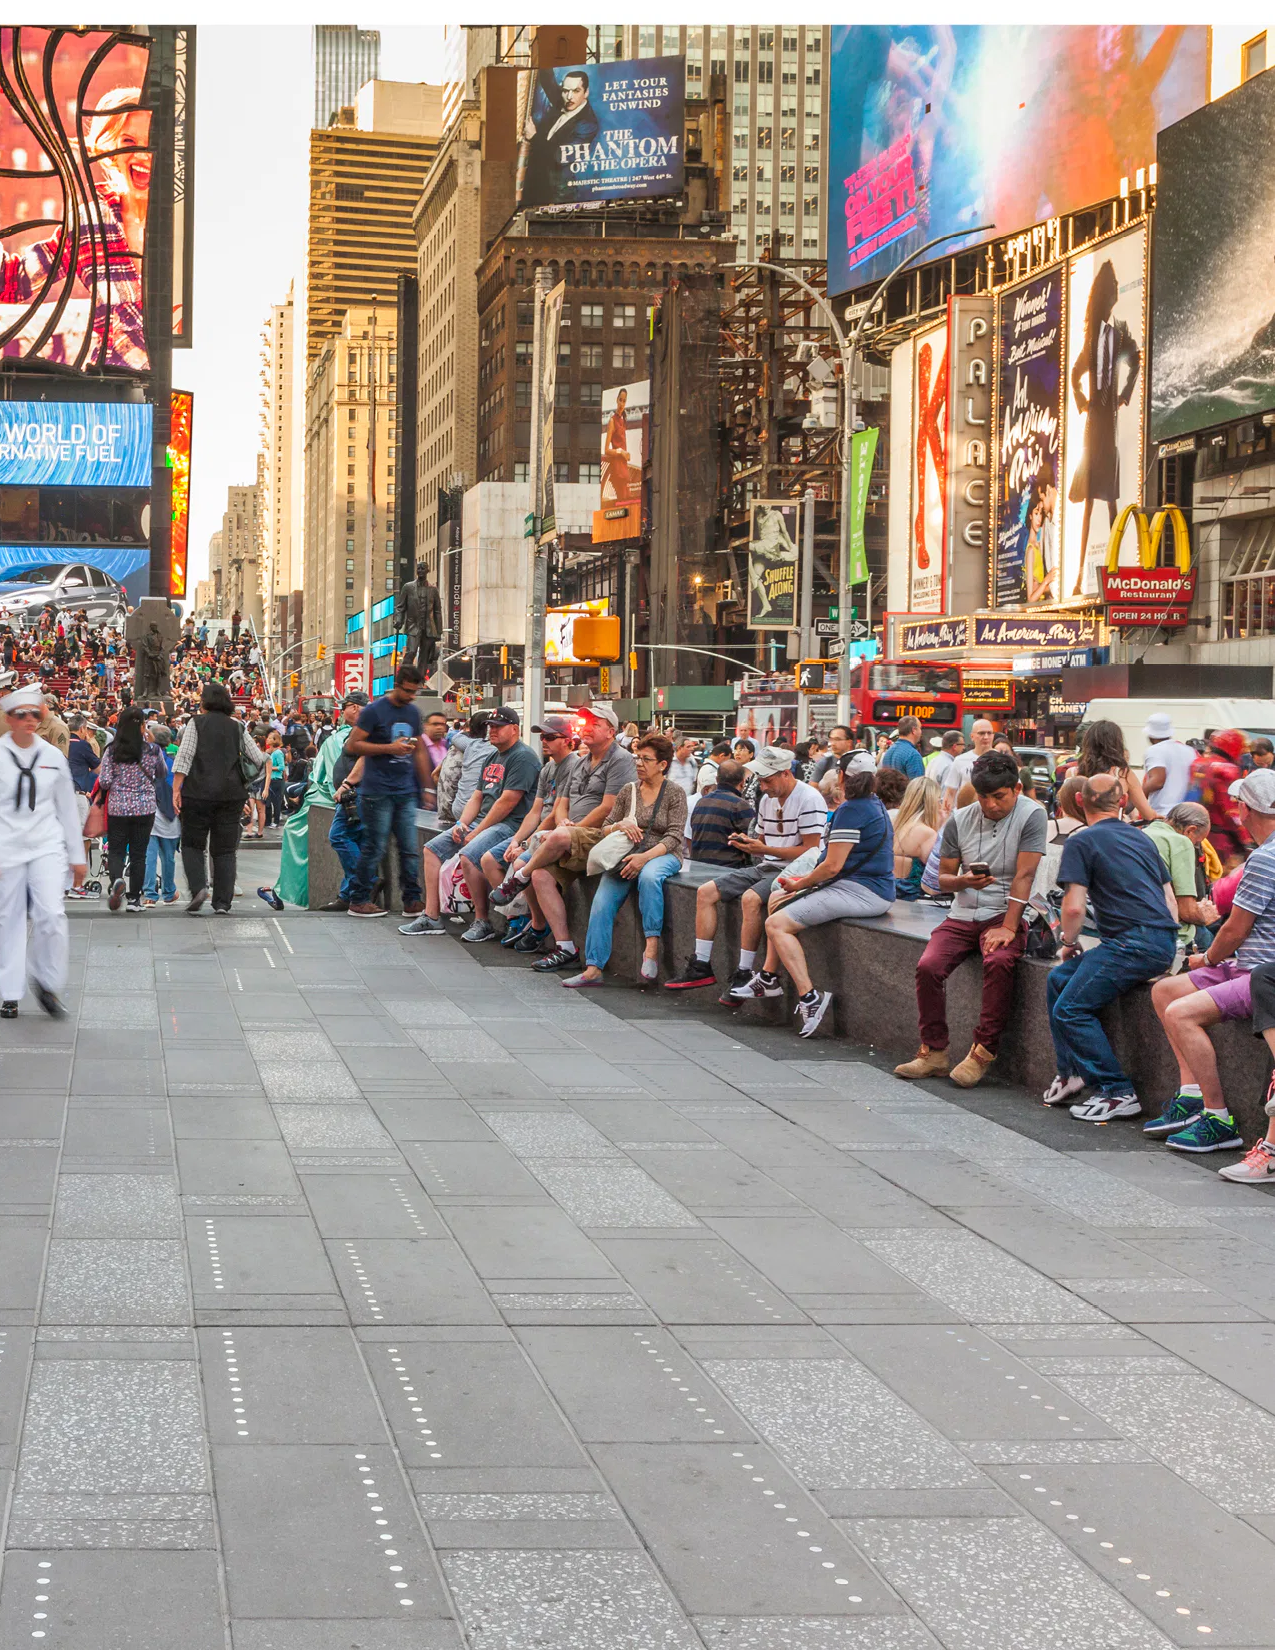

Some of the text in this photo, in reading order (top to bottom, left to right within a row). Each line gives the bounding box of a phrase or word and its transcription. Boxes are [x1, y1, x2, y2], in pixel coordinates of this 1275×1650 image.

[605, 77, 668, 91] LET YOUR
[602, 87, 669, 102] FANTASIES
[609, 99, 661, 111] UNWIND
[603, 129, 633, 141] THE
[559, 135, 679, 164] PHANTOM
[569, 155, 667, 174] OF THE OPERA
[573, 178, 600, 186] MAJESTIC
[845, 186, 868, 218] ON
[869, 155, 913, 200] YOUR
[846, 175, 916, 249] FEET!
[1013, 282, 1052, 321] Winner!
[4, 423, 121, 445] WORLD OF
[962, 317, 988, 547] PALACE
[75, 445, 121, 462] FUEL
[764, 566, 794, 586] SHUFFLE
[768, 581, 794, 600] ALONG
[1107, 578, 1192, 592] McDonald's
[1120, 590, 1176, 599] Restaurant
[832, 608, 838, 618] W
[1112, 612, 1152, 620] OPEN 24
[820, 623, 835, 632] ONE
[981, 622, 1077, 647] An American Paris
[1042, 656, 1066, 669] MONEY
[1070, 654, 1087, 667] ATM
[909, 705, 935, 719] LOOP
[1050, 705, 1086, 713] MONEY
